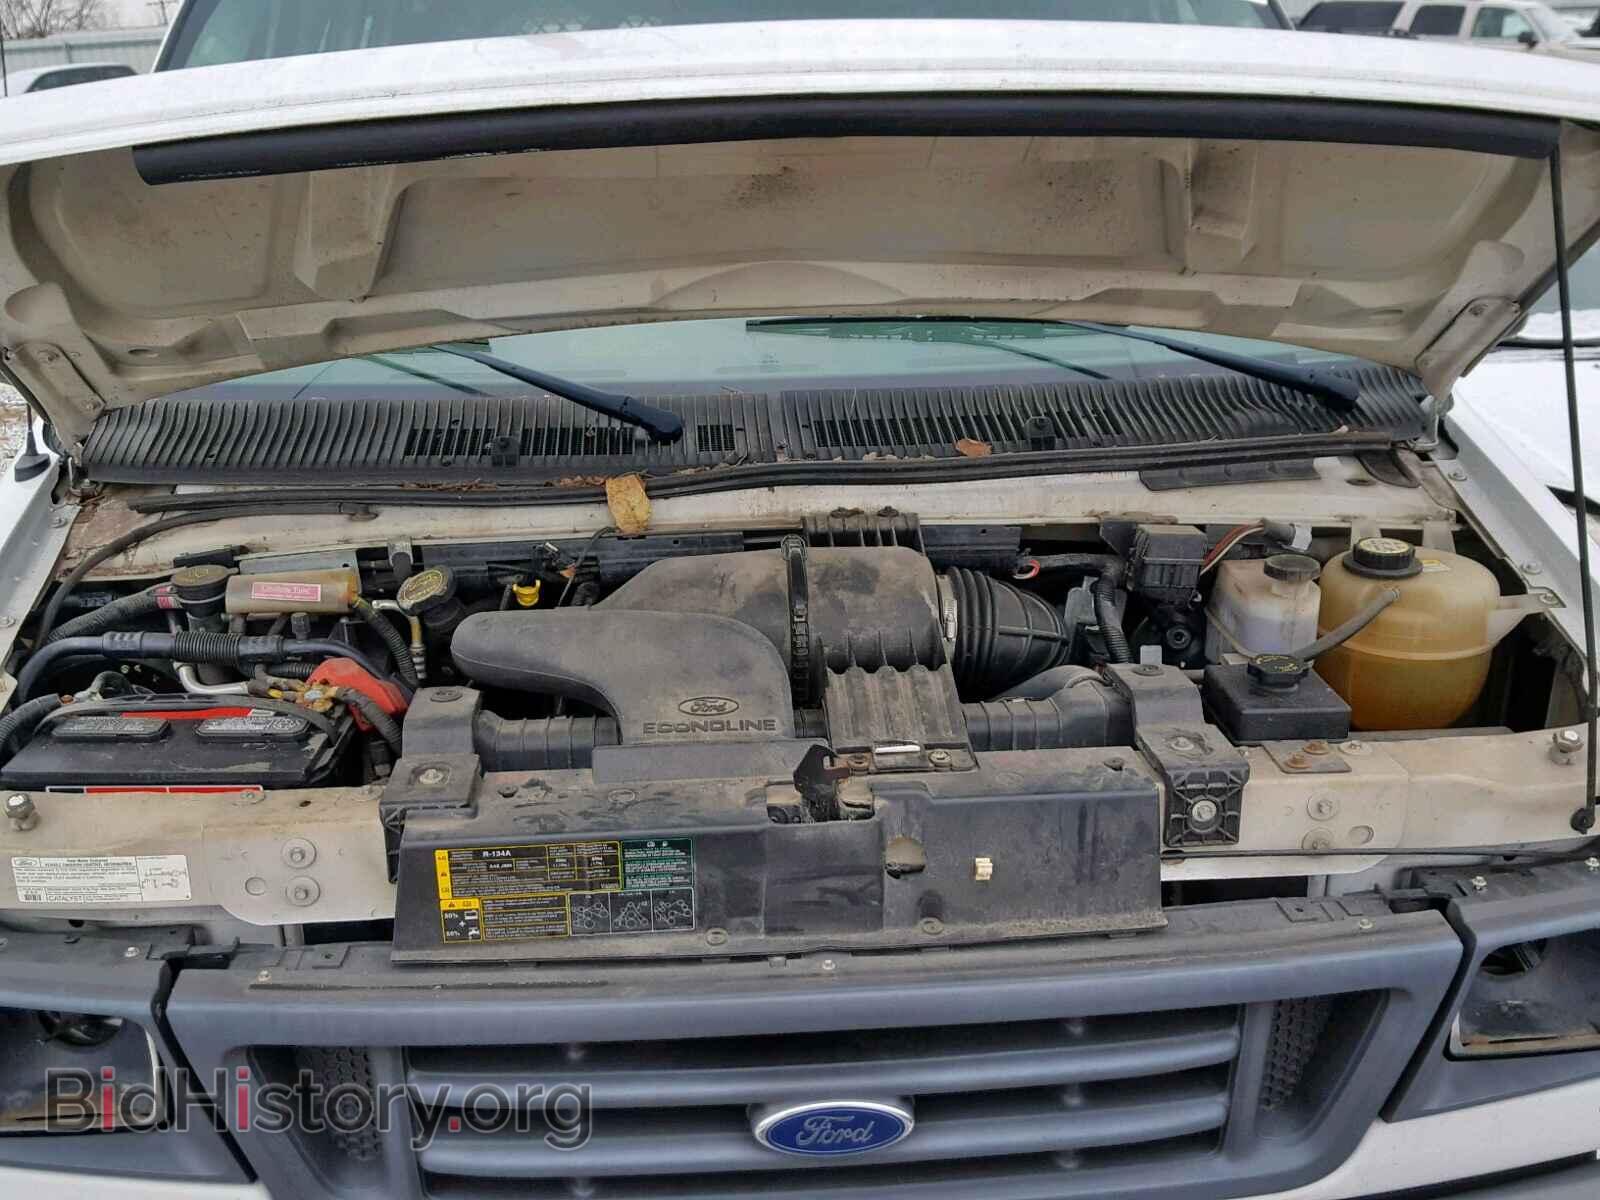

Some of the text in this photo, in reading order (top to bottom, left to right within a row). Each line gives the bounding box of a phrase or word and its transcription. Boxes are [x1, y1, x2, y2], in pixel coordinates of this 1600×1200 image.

[690, 699, 728, 713] Ford
[642, 719, 777, 734] ECONOLINE
[482, 849, 512, 858] R-134A
[796, 1115, 875, 1146] Ford
